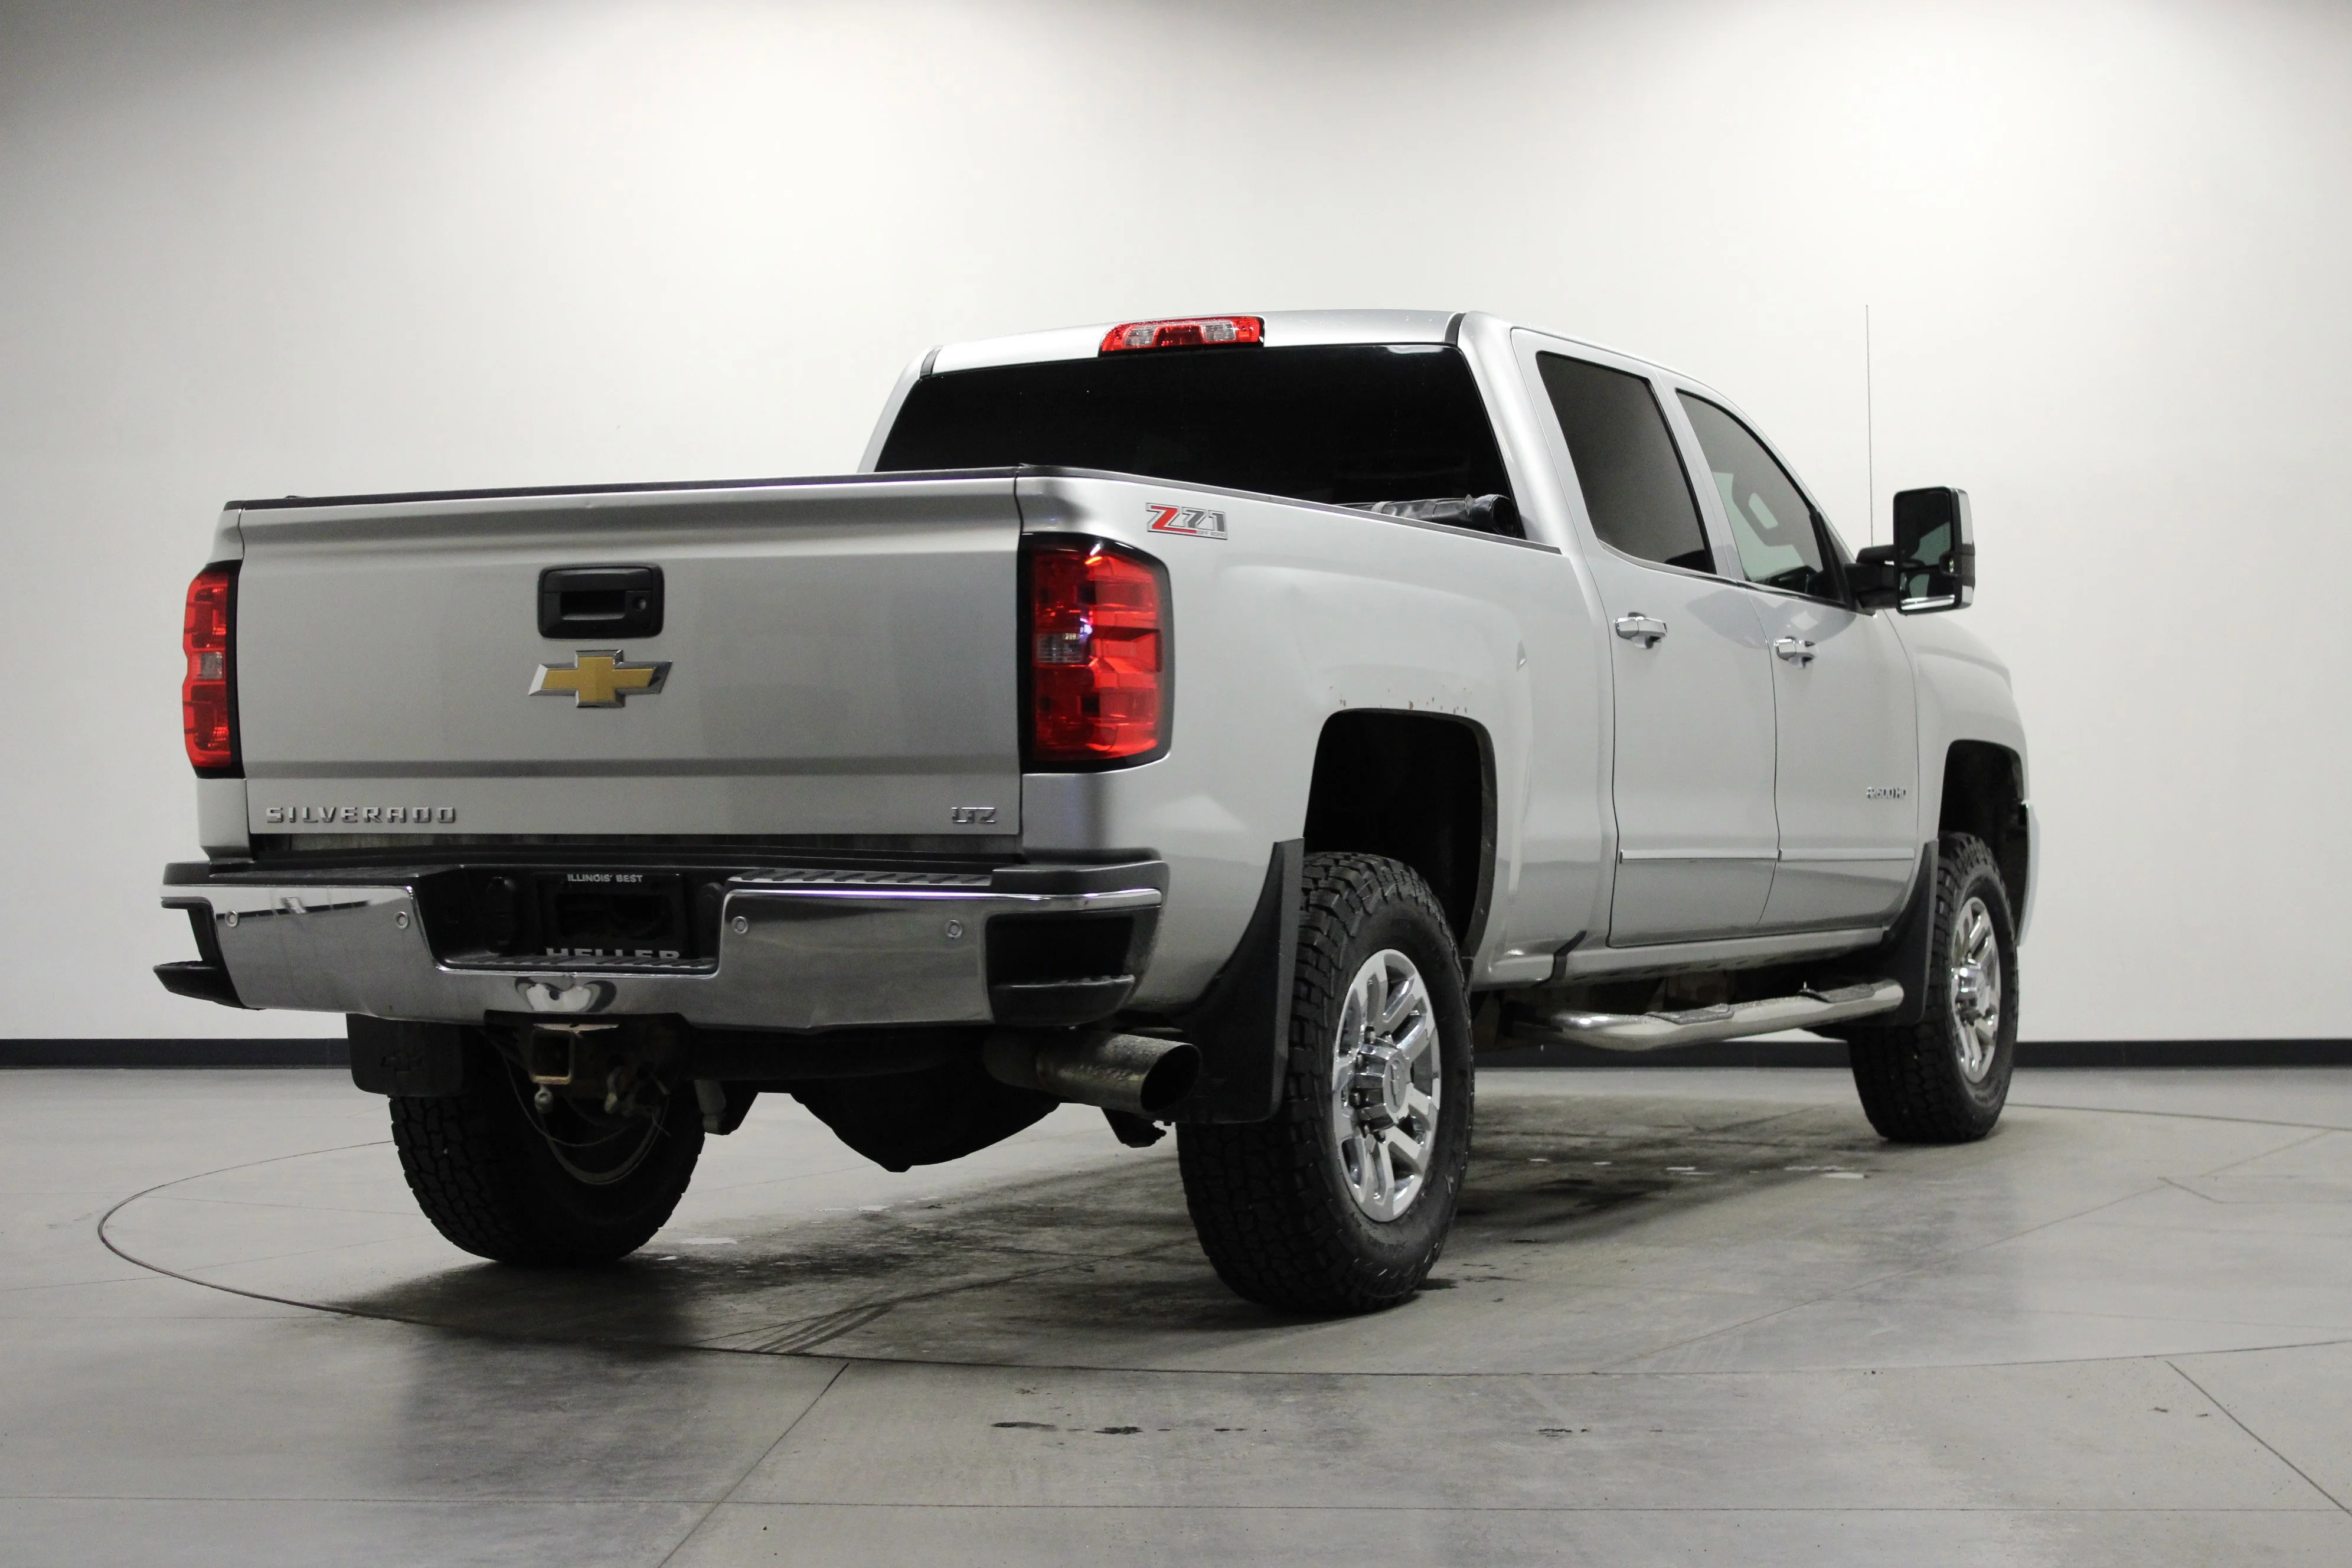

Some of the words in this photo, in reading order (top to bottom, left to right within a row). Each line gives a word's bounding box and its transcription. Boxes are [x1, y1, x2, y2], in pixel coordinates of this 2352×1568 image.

[1146, 502, 1228, 540] Z71
[266, 806, 456, 824] SILVERADO
[950, 806, 996, 824] LTZ
[567, 874, 612, 882] ILLINOIS'
[616, 874, 643, 883] BEST
